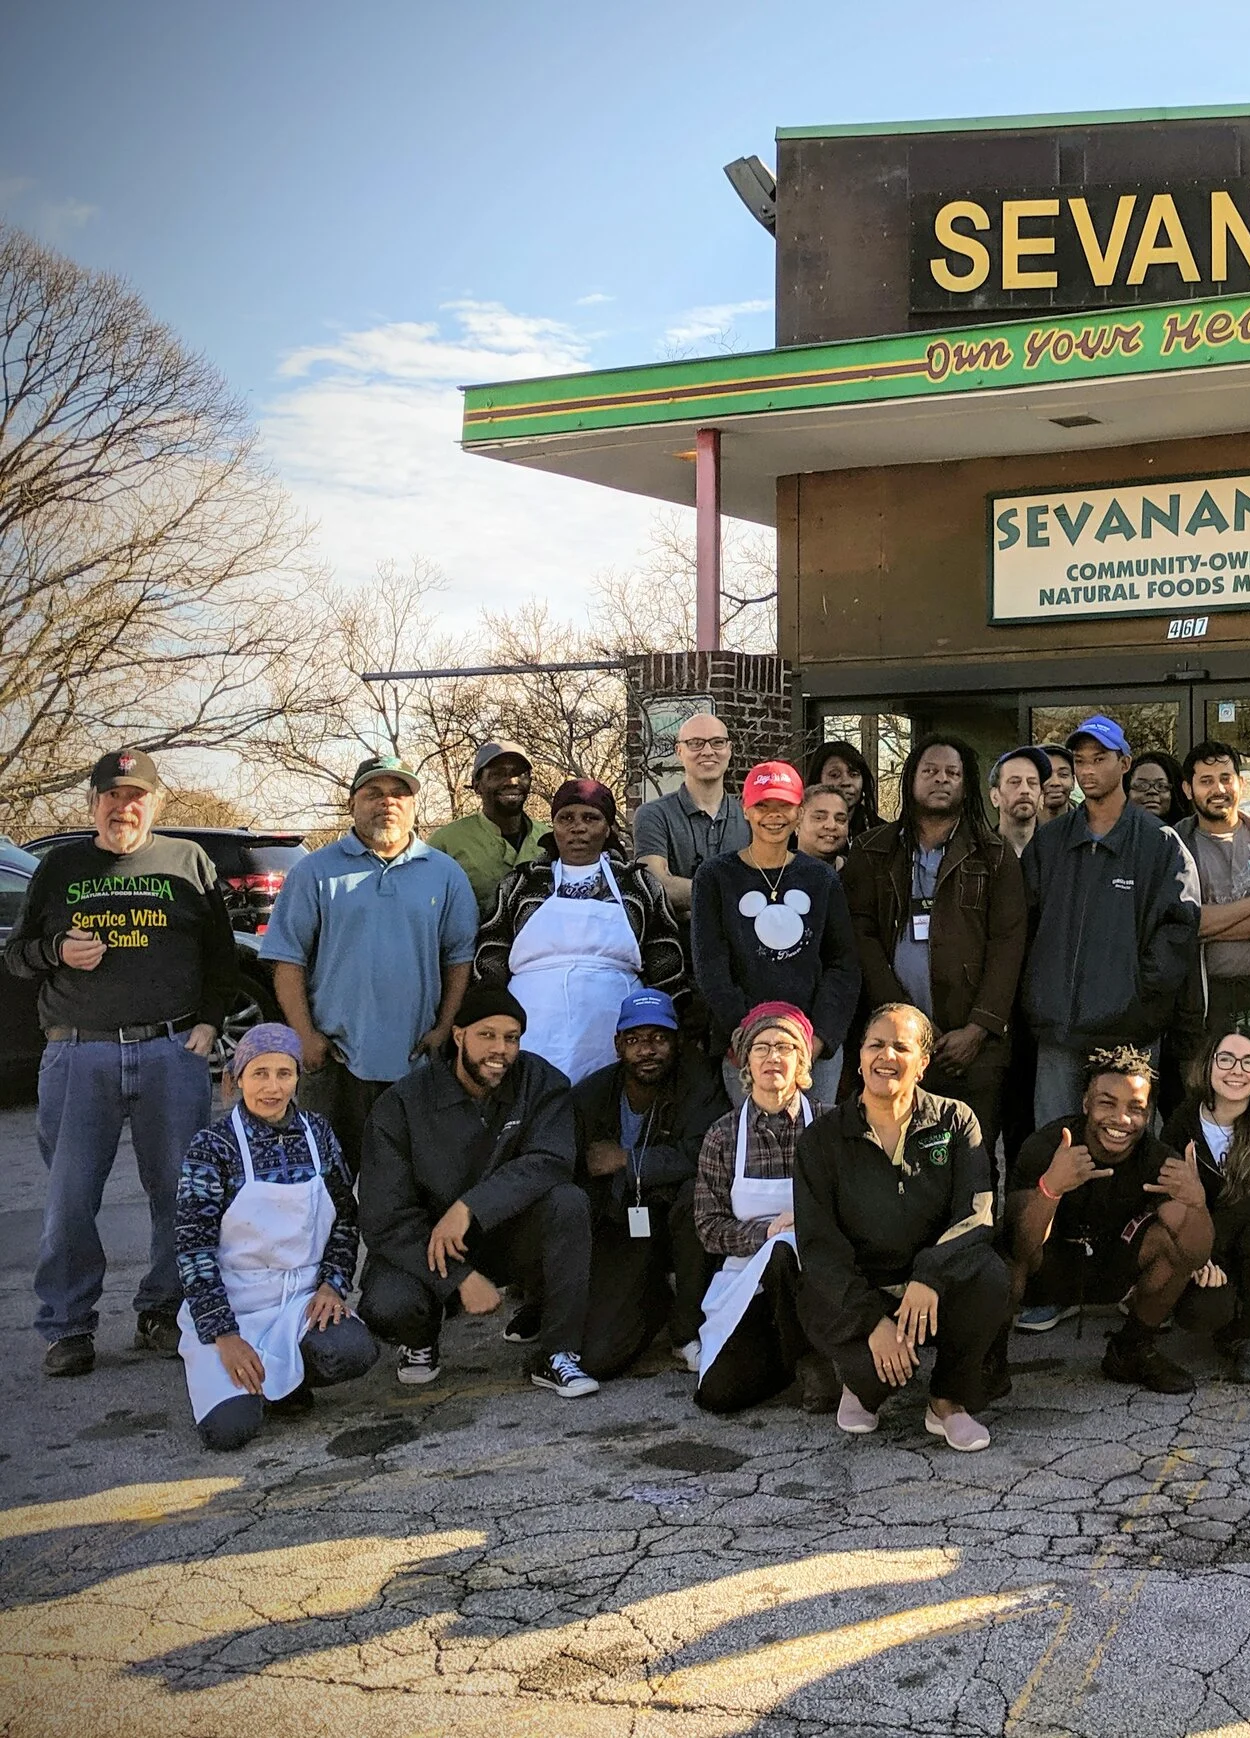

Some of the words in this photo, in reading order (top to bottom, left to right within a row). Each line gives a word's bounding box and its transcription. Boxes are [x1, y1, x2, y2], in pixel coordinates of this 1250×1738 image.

[927, 338, 1014, 384] Own
[1039, 578, 1140, 606] NATURAL
[1147, 575, 1225, 599] FOODS
[1169, 618, 1206, 636] 467
[66, 876, 175, 905] SEVANANDA
[80, 891, 110, 900] NATURAL
[133, 890, 161, 898] MARKET
[71, 910, 126, 929] Service
[130, 908, 168, 927] With
[107, 929, 149, 948] Smile
